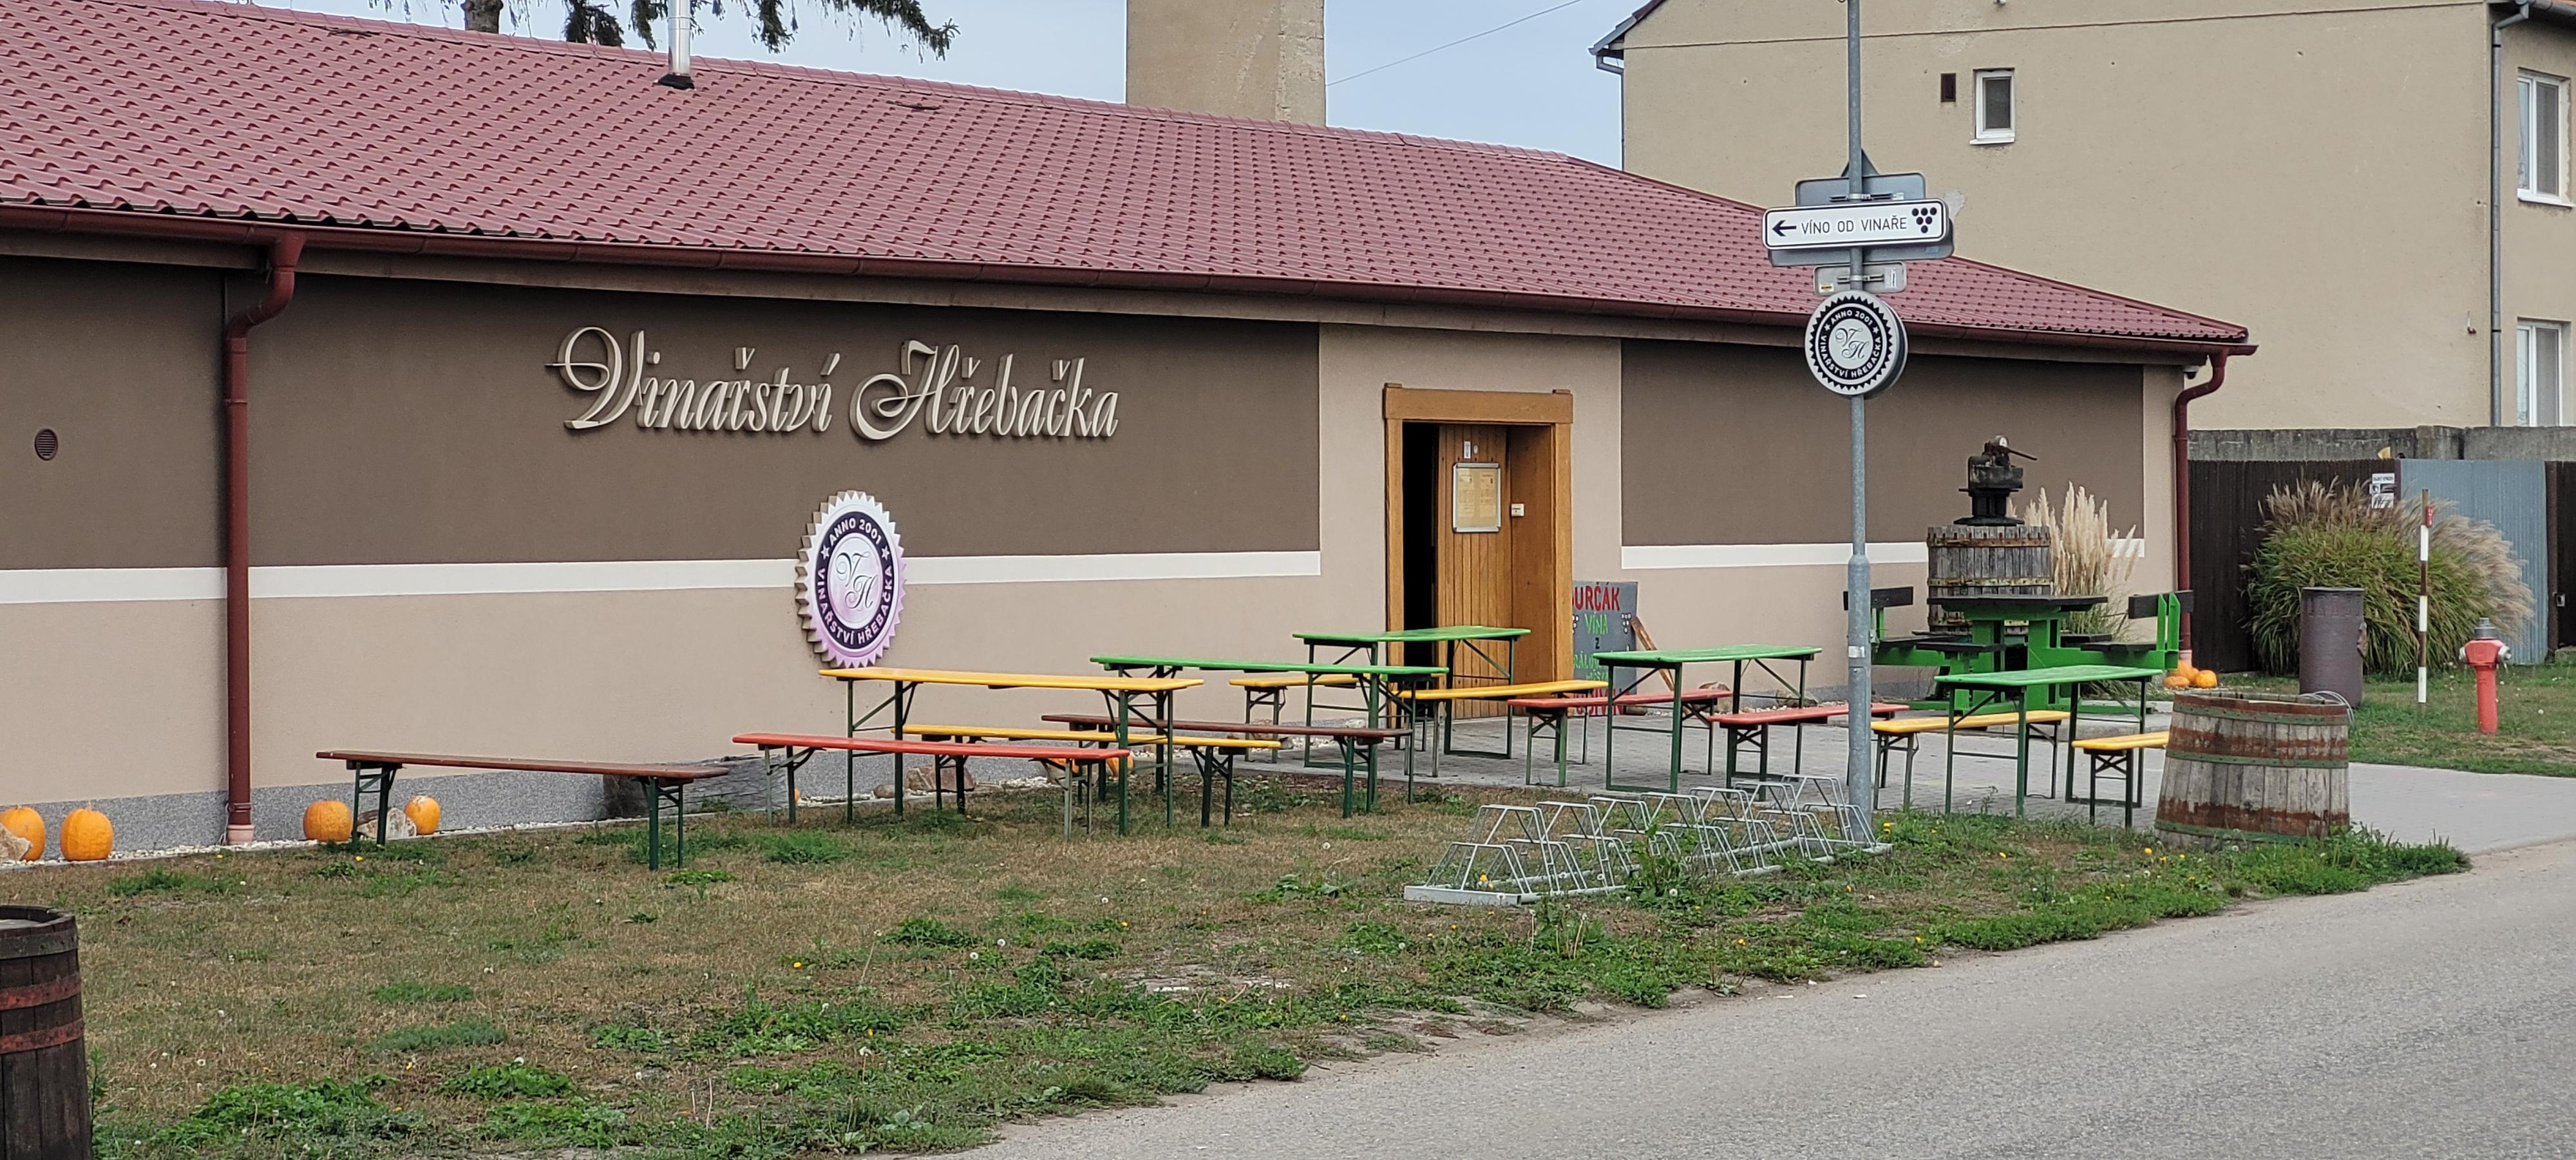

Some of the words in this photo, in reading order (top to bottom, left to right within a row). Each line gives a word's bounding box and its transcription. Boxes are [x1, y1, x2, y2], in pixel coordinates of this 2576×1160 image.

[1801, 219, 1830, 234] VÍNO
[1837, 220, 1854, 233] OD
[1861, 214, 1908, 232] VINAŘE
[1831, 310, 1853, 325] ANNO
[1855, 310, 1873, 326] 2001
[545, 326, 840, 433] Vinařství
[849, 339, 1119, 441] Hřebačka
[829, 517, 856, 546] ANNO
[858, 518, 882, 545] 2001
[817, 567, 854, 645] VINAŘSTVÍ
[858, 564, 893, 645] HŘEBAČKA
[1572, 581, 1620, 611] URČÁK
